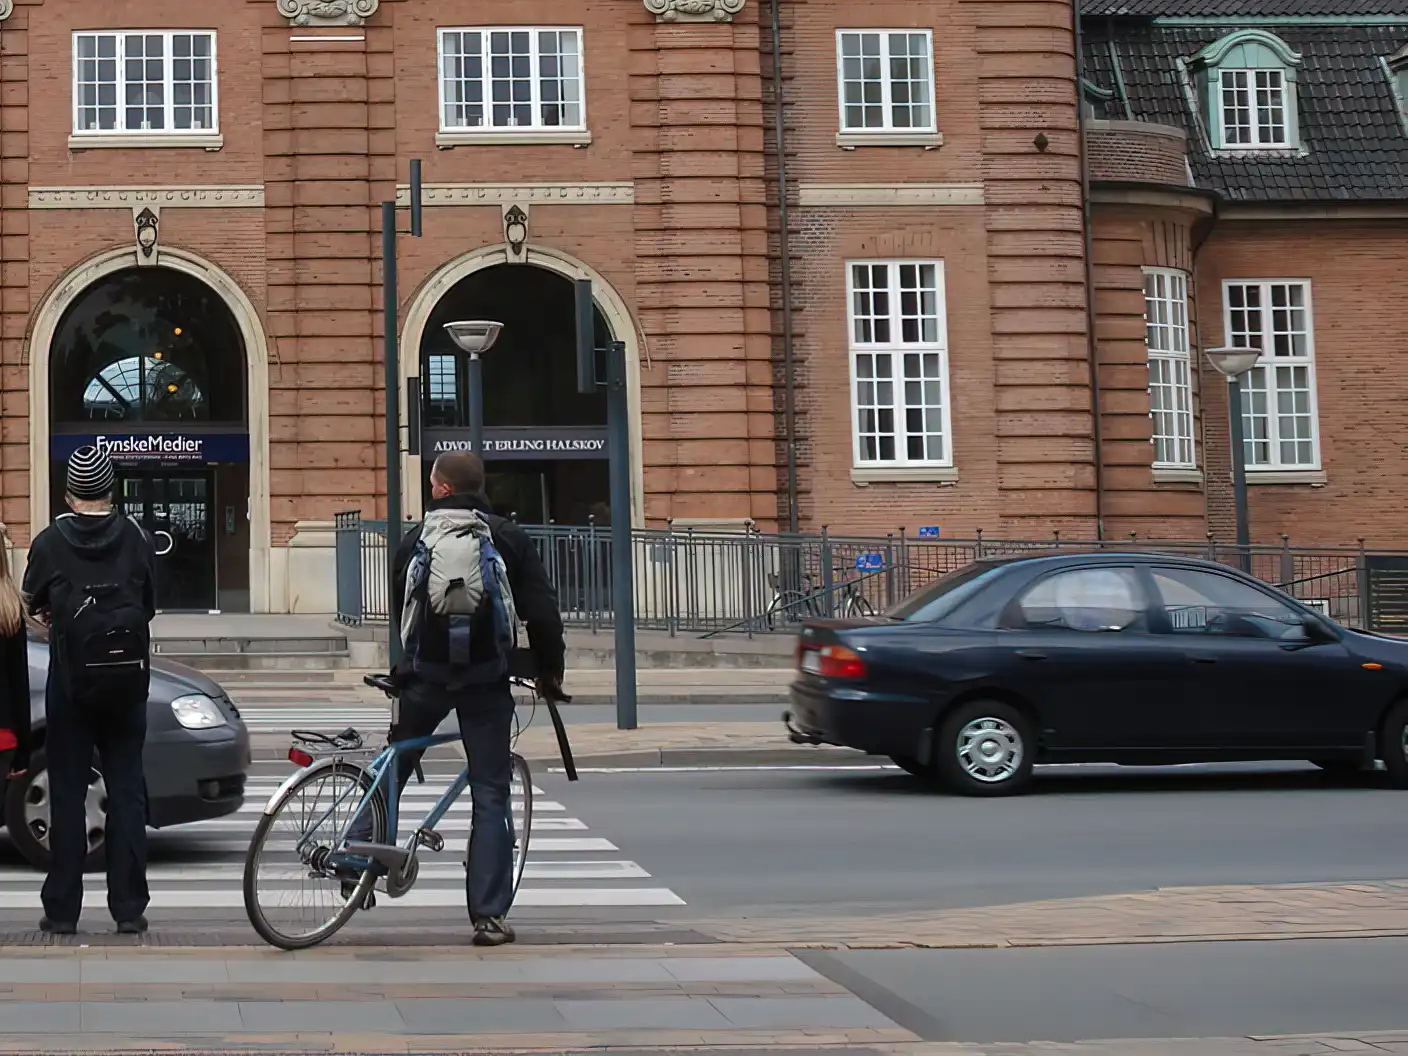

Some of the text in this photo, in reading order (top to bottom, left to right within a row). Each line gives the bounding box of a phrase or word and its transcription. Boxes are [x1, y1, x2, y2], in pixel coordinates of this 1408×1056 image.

[96, 436, 203, 456] FynskeMedier
[433, 439, 605, 451] ADVOT ERLING HALSKOV
